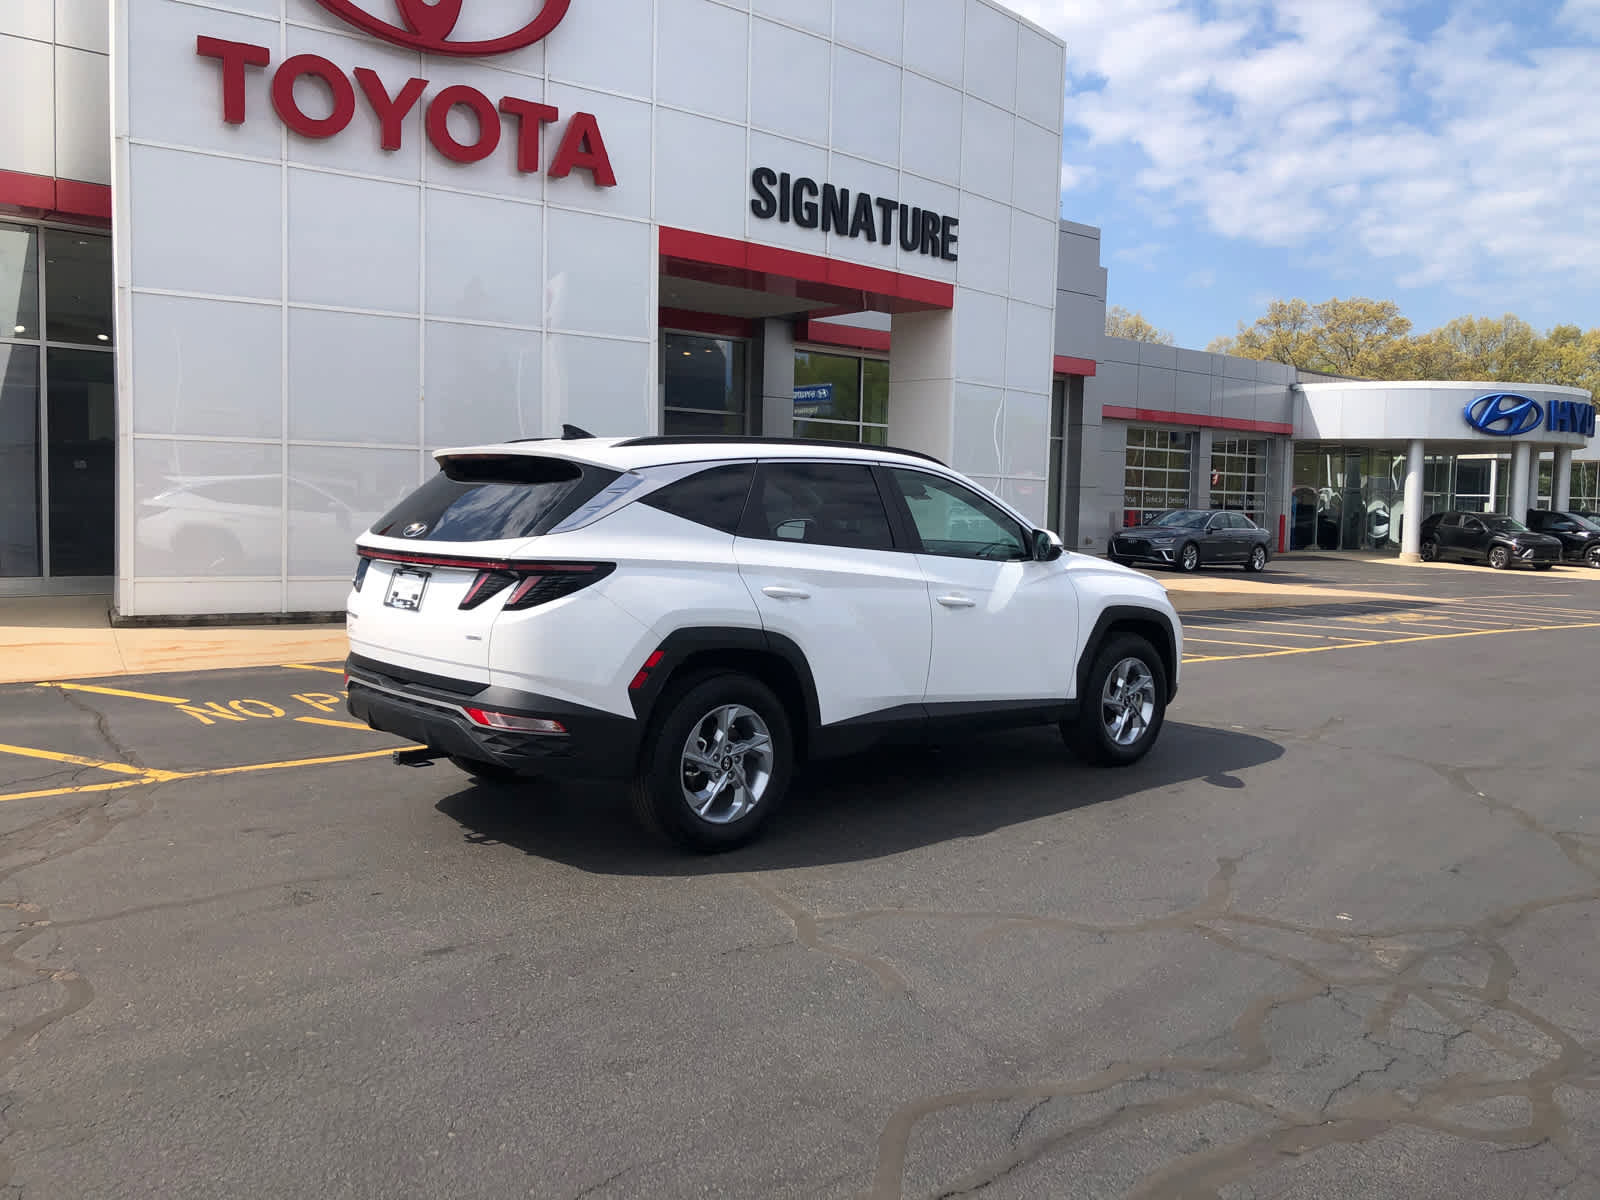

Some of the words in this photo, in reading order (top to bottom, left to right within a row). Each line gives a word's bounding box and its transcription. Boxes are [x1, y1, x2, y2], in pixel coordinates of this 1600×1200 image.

[196, 34, 617, 188] TOYOTA
[751, 166, 959, 262] SIGNATURE
[174, 699, 286, 725] NO
